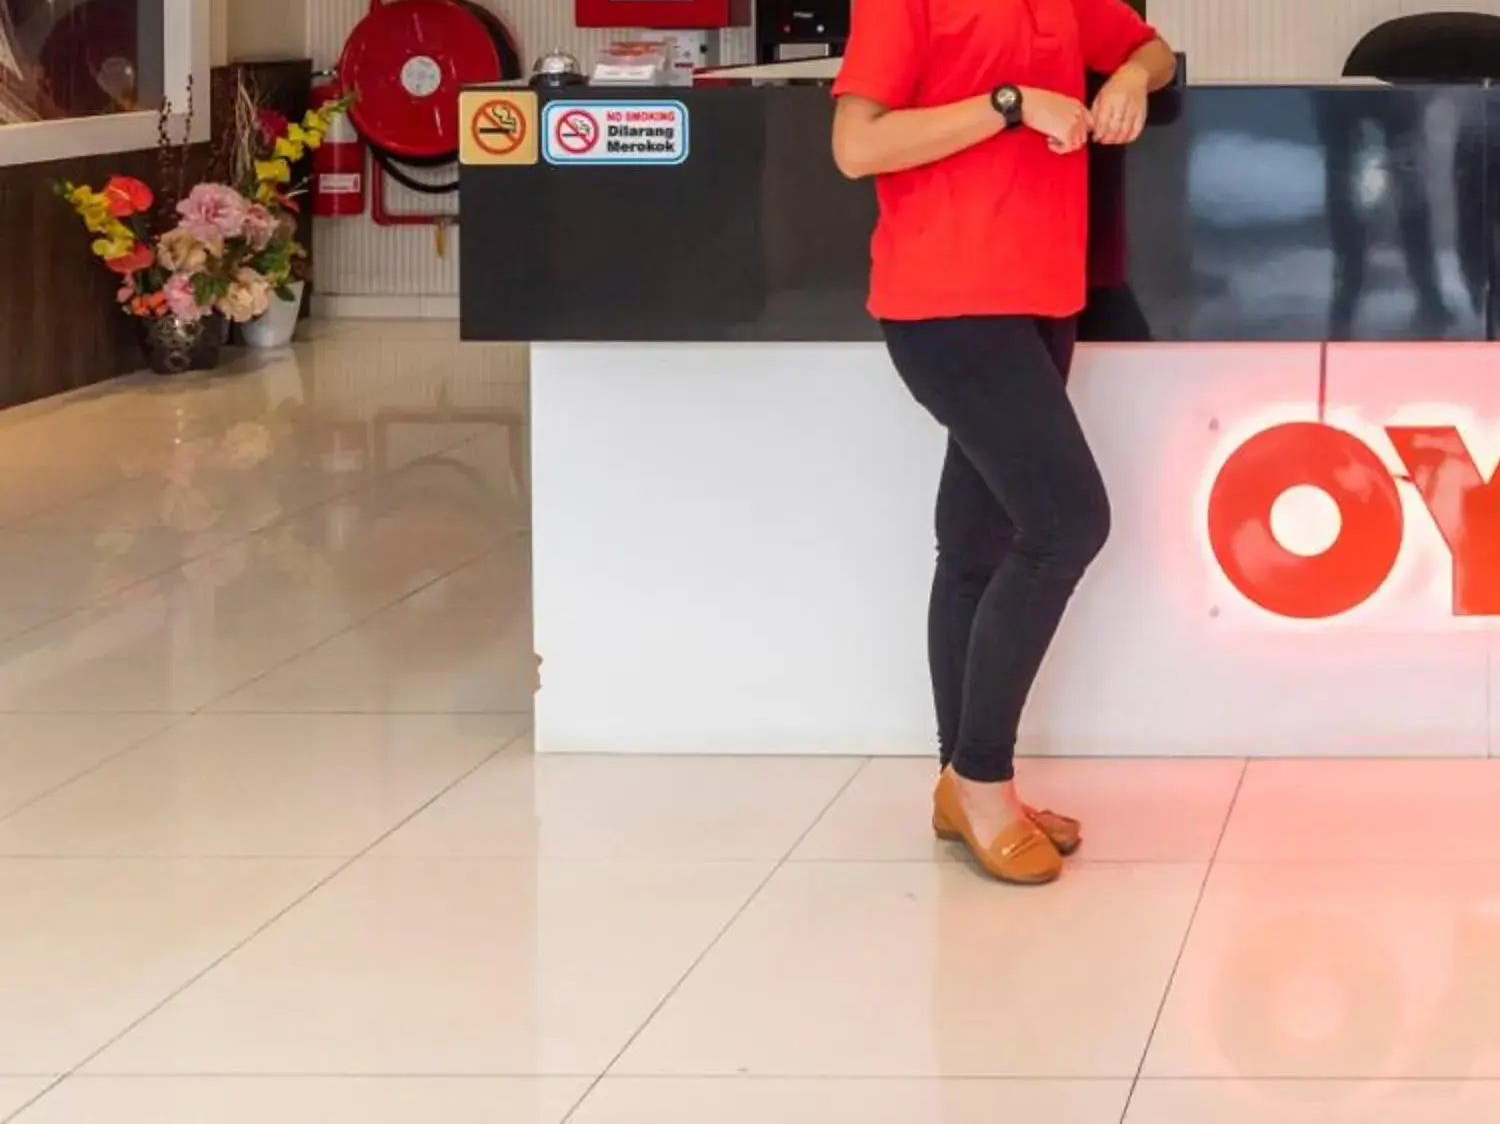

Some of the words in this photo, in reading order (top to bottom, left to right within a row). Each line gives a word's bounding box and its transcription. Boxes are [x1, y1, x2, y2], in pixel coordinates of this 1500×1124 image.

[606, 111, 622, 122] NO
[626, 111, 675, 122] SMOKING
[607, 125, 675, 139] Dilarang
[607, 140, 675, 153] Merokok
